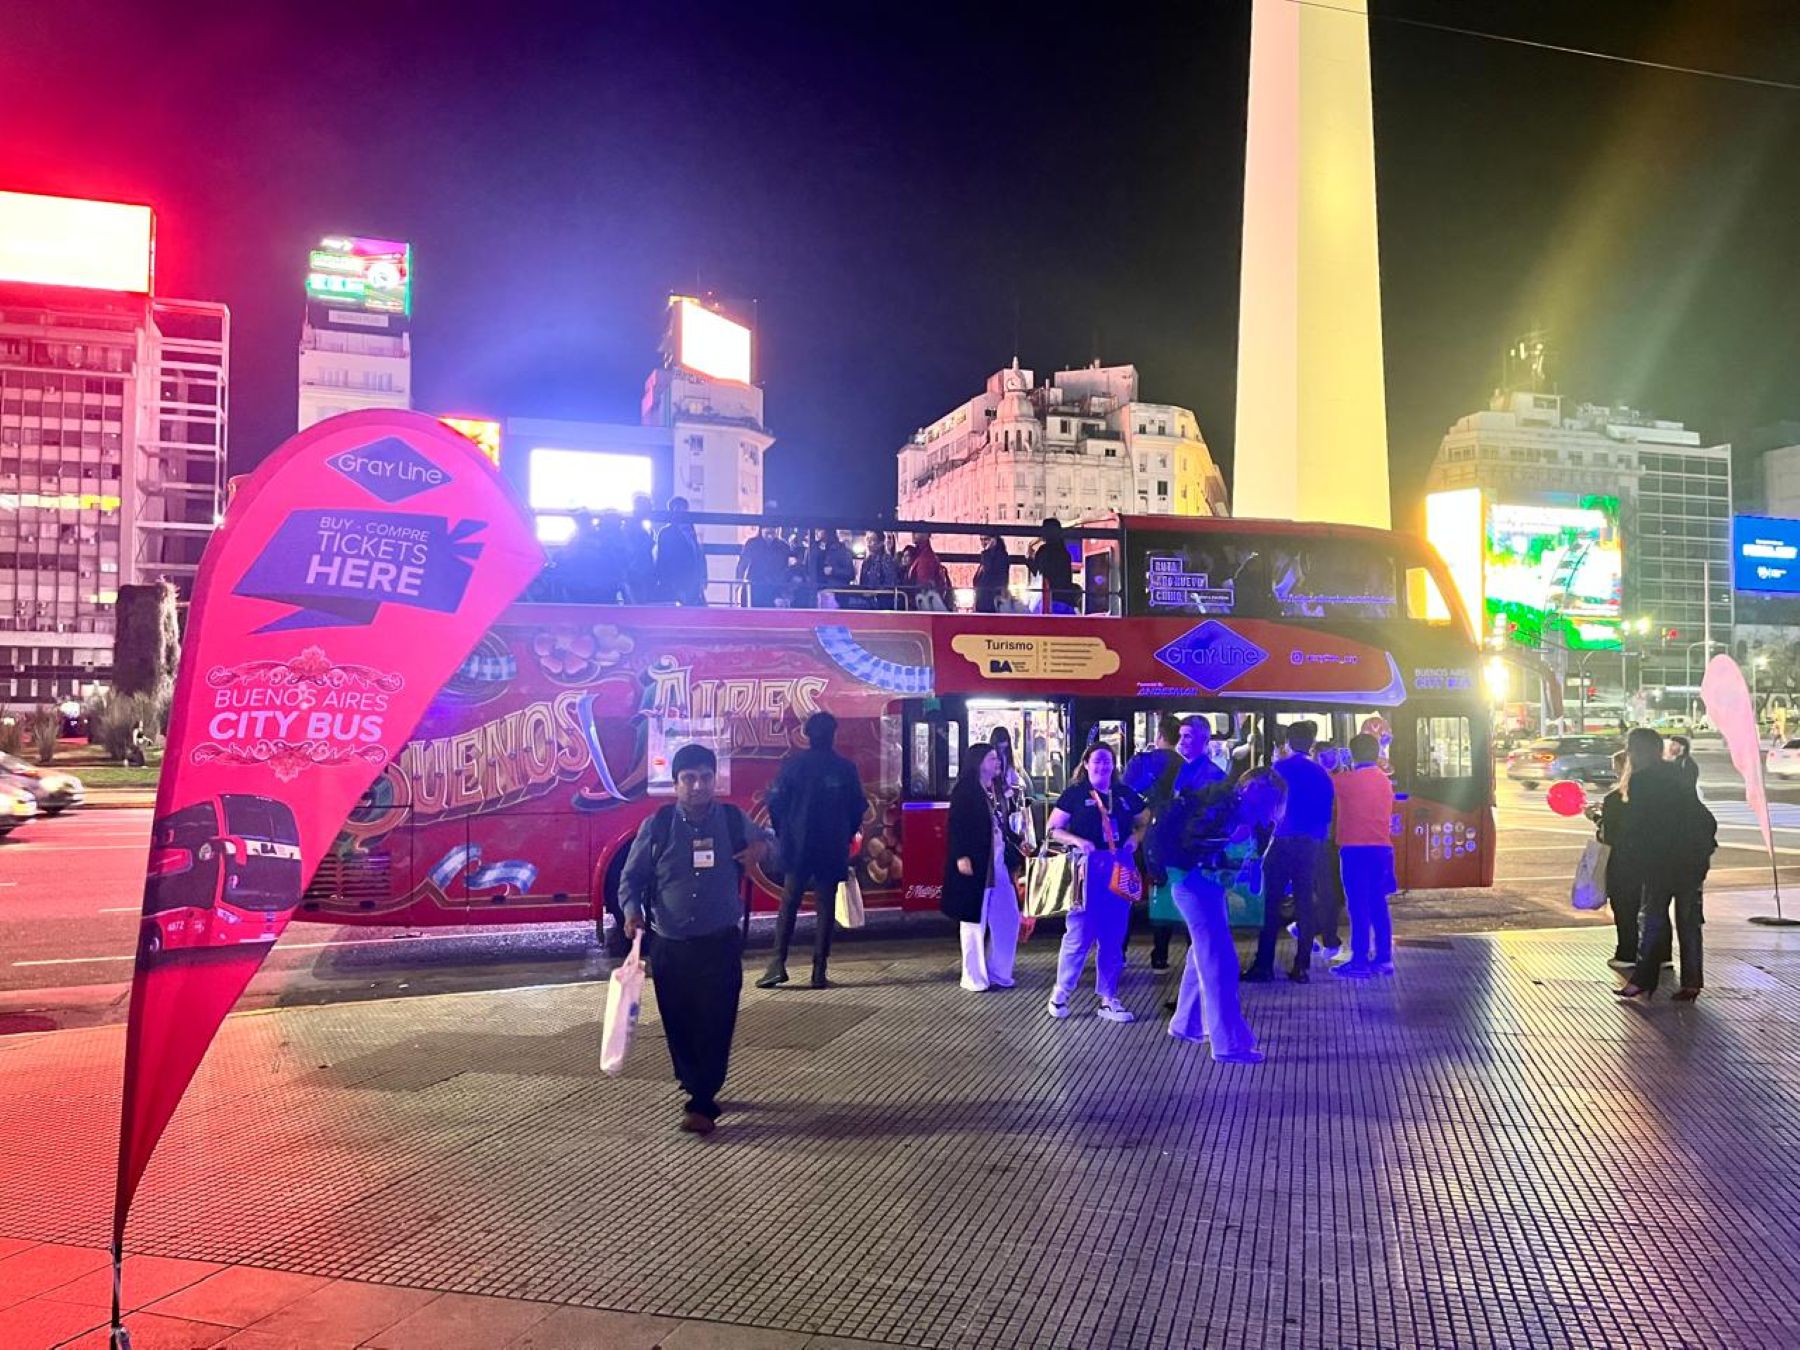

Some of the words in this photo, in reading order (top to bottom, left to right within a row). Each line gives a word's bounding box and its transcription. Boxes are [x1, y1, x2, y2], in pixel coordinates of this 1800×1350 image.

[319, 516, 354, 530] BUY
[366, 522, 430, 542] COMPRE
[317, 530, 428, 565] TICKETS
[305, 554, 425, 597] HERE
[985, 639, 1034, 650] Turismo
[990, 660, 1012, 673] BA
[214, 688, 318, 709] BUENOS
[322, 691, 389, 712] AIRES
[208, 711, 300, 740] CITY
[307, 712, 384, 743] BUS
